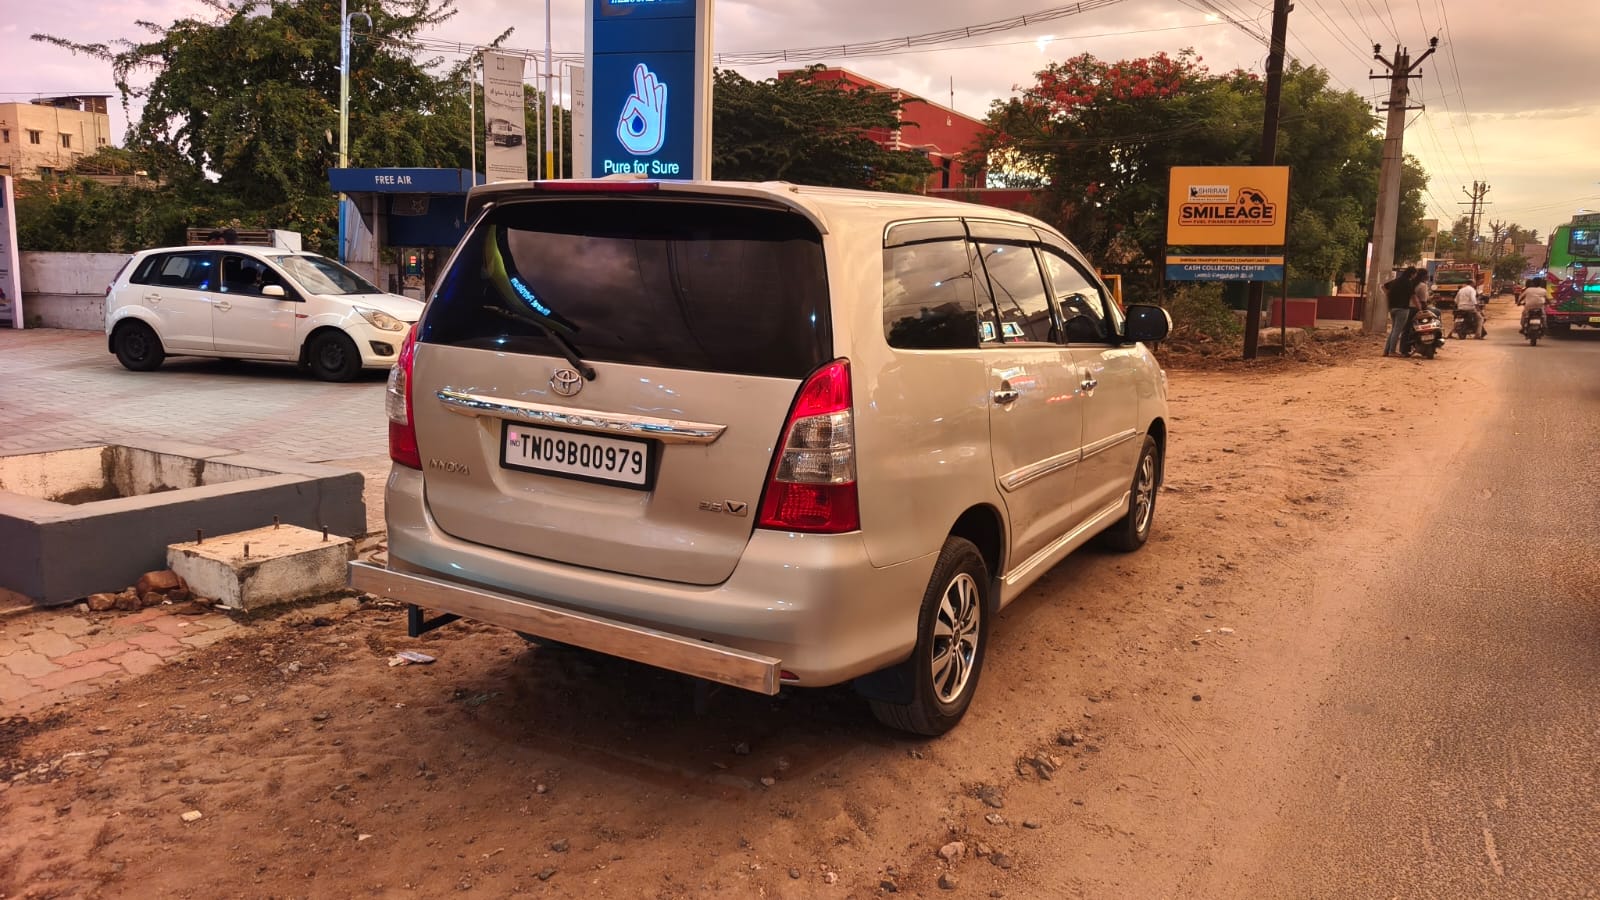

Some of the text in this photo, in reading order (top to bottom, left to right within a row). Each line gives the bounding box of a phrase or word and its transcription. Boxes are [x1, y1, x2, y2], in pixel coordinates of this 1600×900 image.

[604, 159, 680, 174] Pure for Sure
[375, 175, 413, 185] FREE AIR
[1198, 187, 1228, 195] SHRIRAM
[1182, 206, 1273, 219] SMILEAGE
[521, 433, 643, 475] TN09BQ0979
[428, 459, 471, 476] INNOVA
